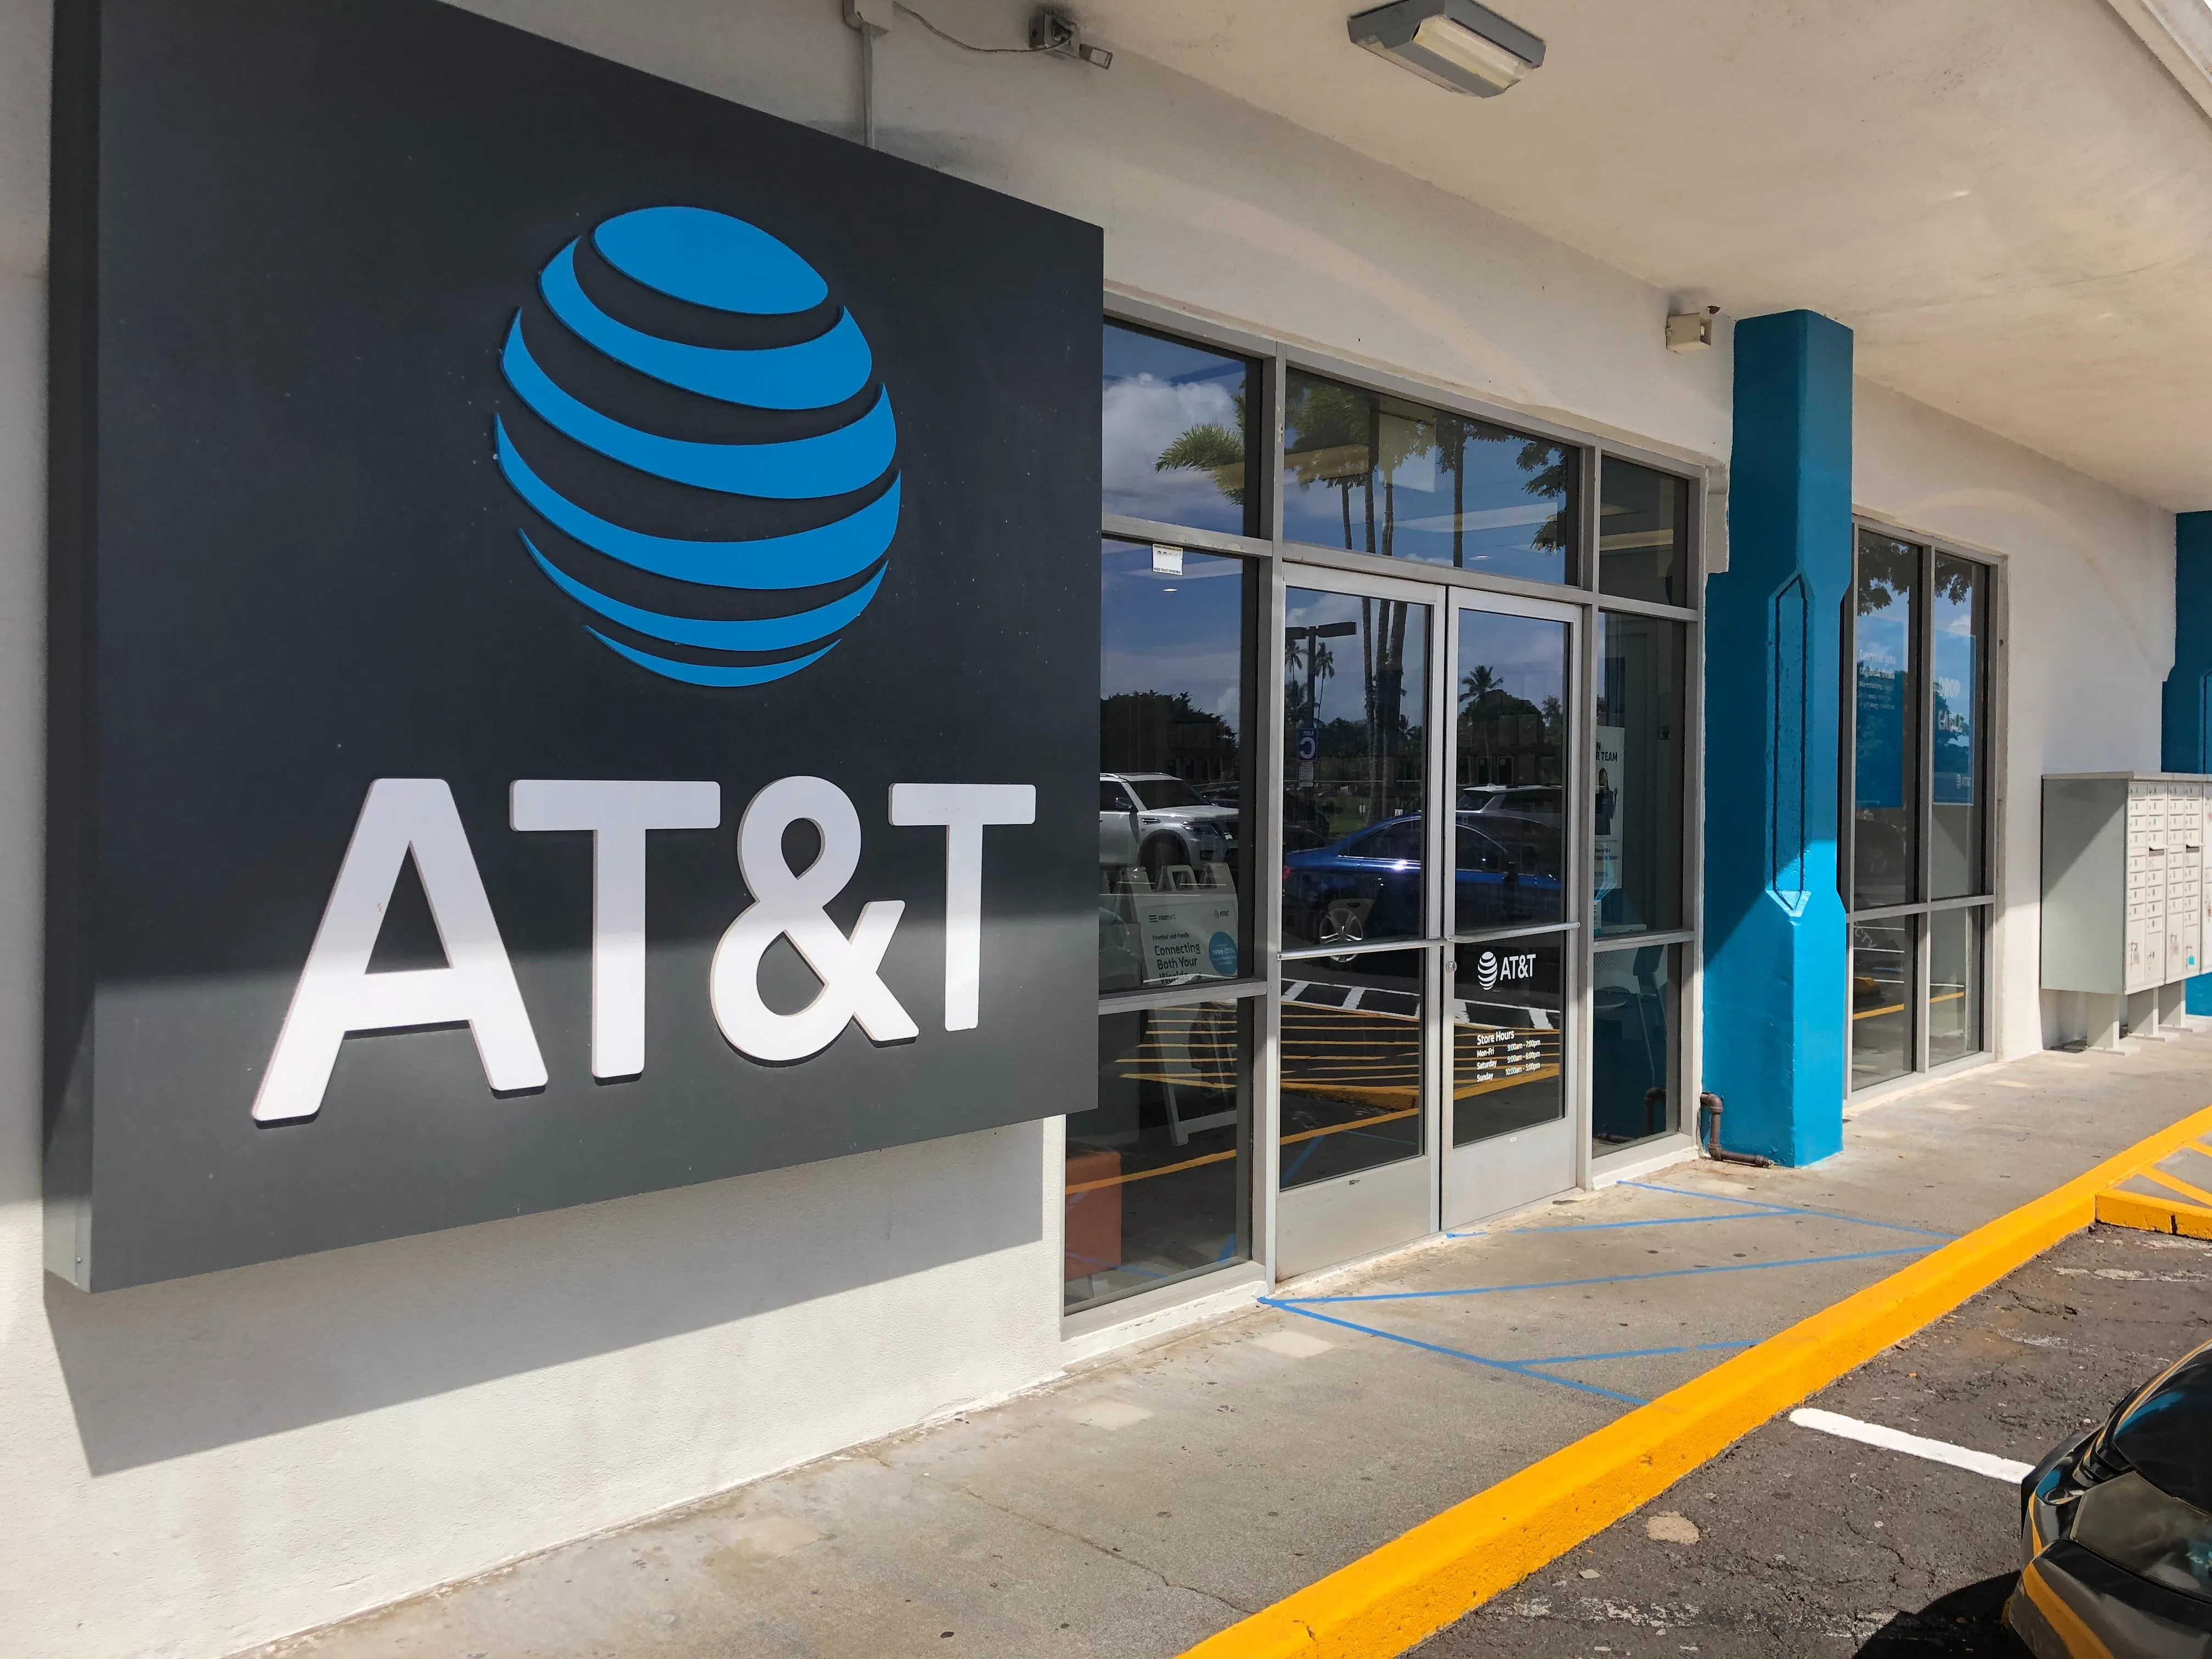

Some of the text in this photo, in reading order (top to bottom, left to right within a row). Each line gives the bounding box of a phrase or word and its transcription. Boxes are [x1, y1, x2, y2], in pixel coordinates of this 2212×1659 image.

[1601, 751, 1618, 761] TEAM
[251, 775, 1036, 1122] AT&T
[1154, 943, 1201, 956] Connecting
[1157, 957, 1198, 970] Both Your
[1500, 953, 1536, 980] AT&T
[1477, 1030, 1515, 1045] Store Hours
[1476, 1047, 1494, 1058] Mon-Fri
[1507, 1043, 1523, 1051] 9:00am
[1526, 1039, 1541, 1048] 7:00pm
[1476, 1059, 1497, 1070] Saturday
[1507, 1054, 1523, 1064] 9:00am
[1525, 1051, 1541, 1060] 6:00pm
[1476, 1072, 1493, 1082] Sunday
[1505, 1066, 1522, 1076] 10:00am
[1526, 1062, 1541, 1072] 5:00pm
